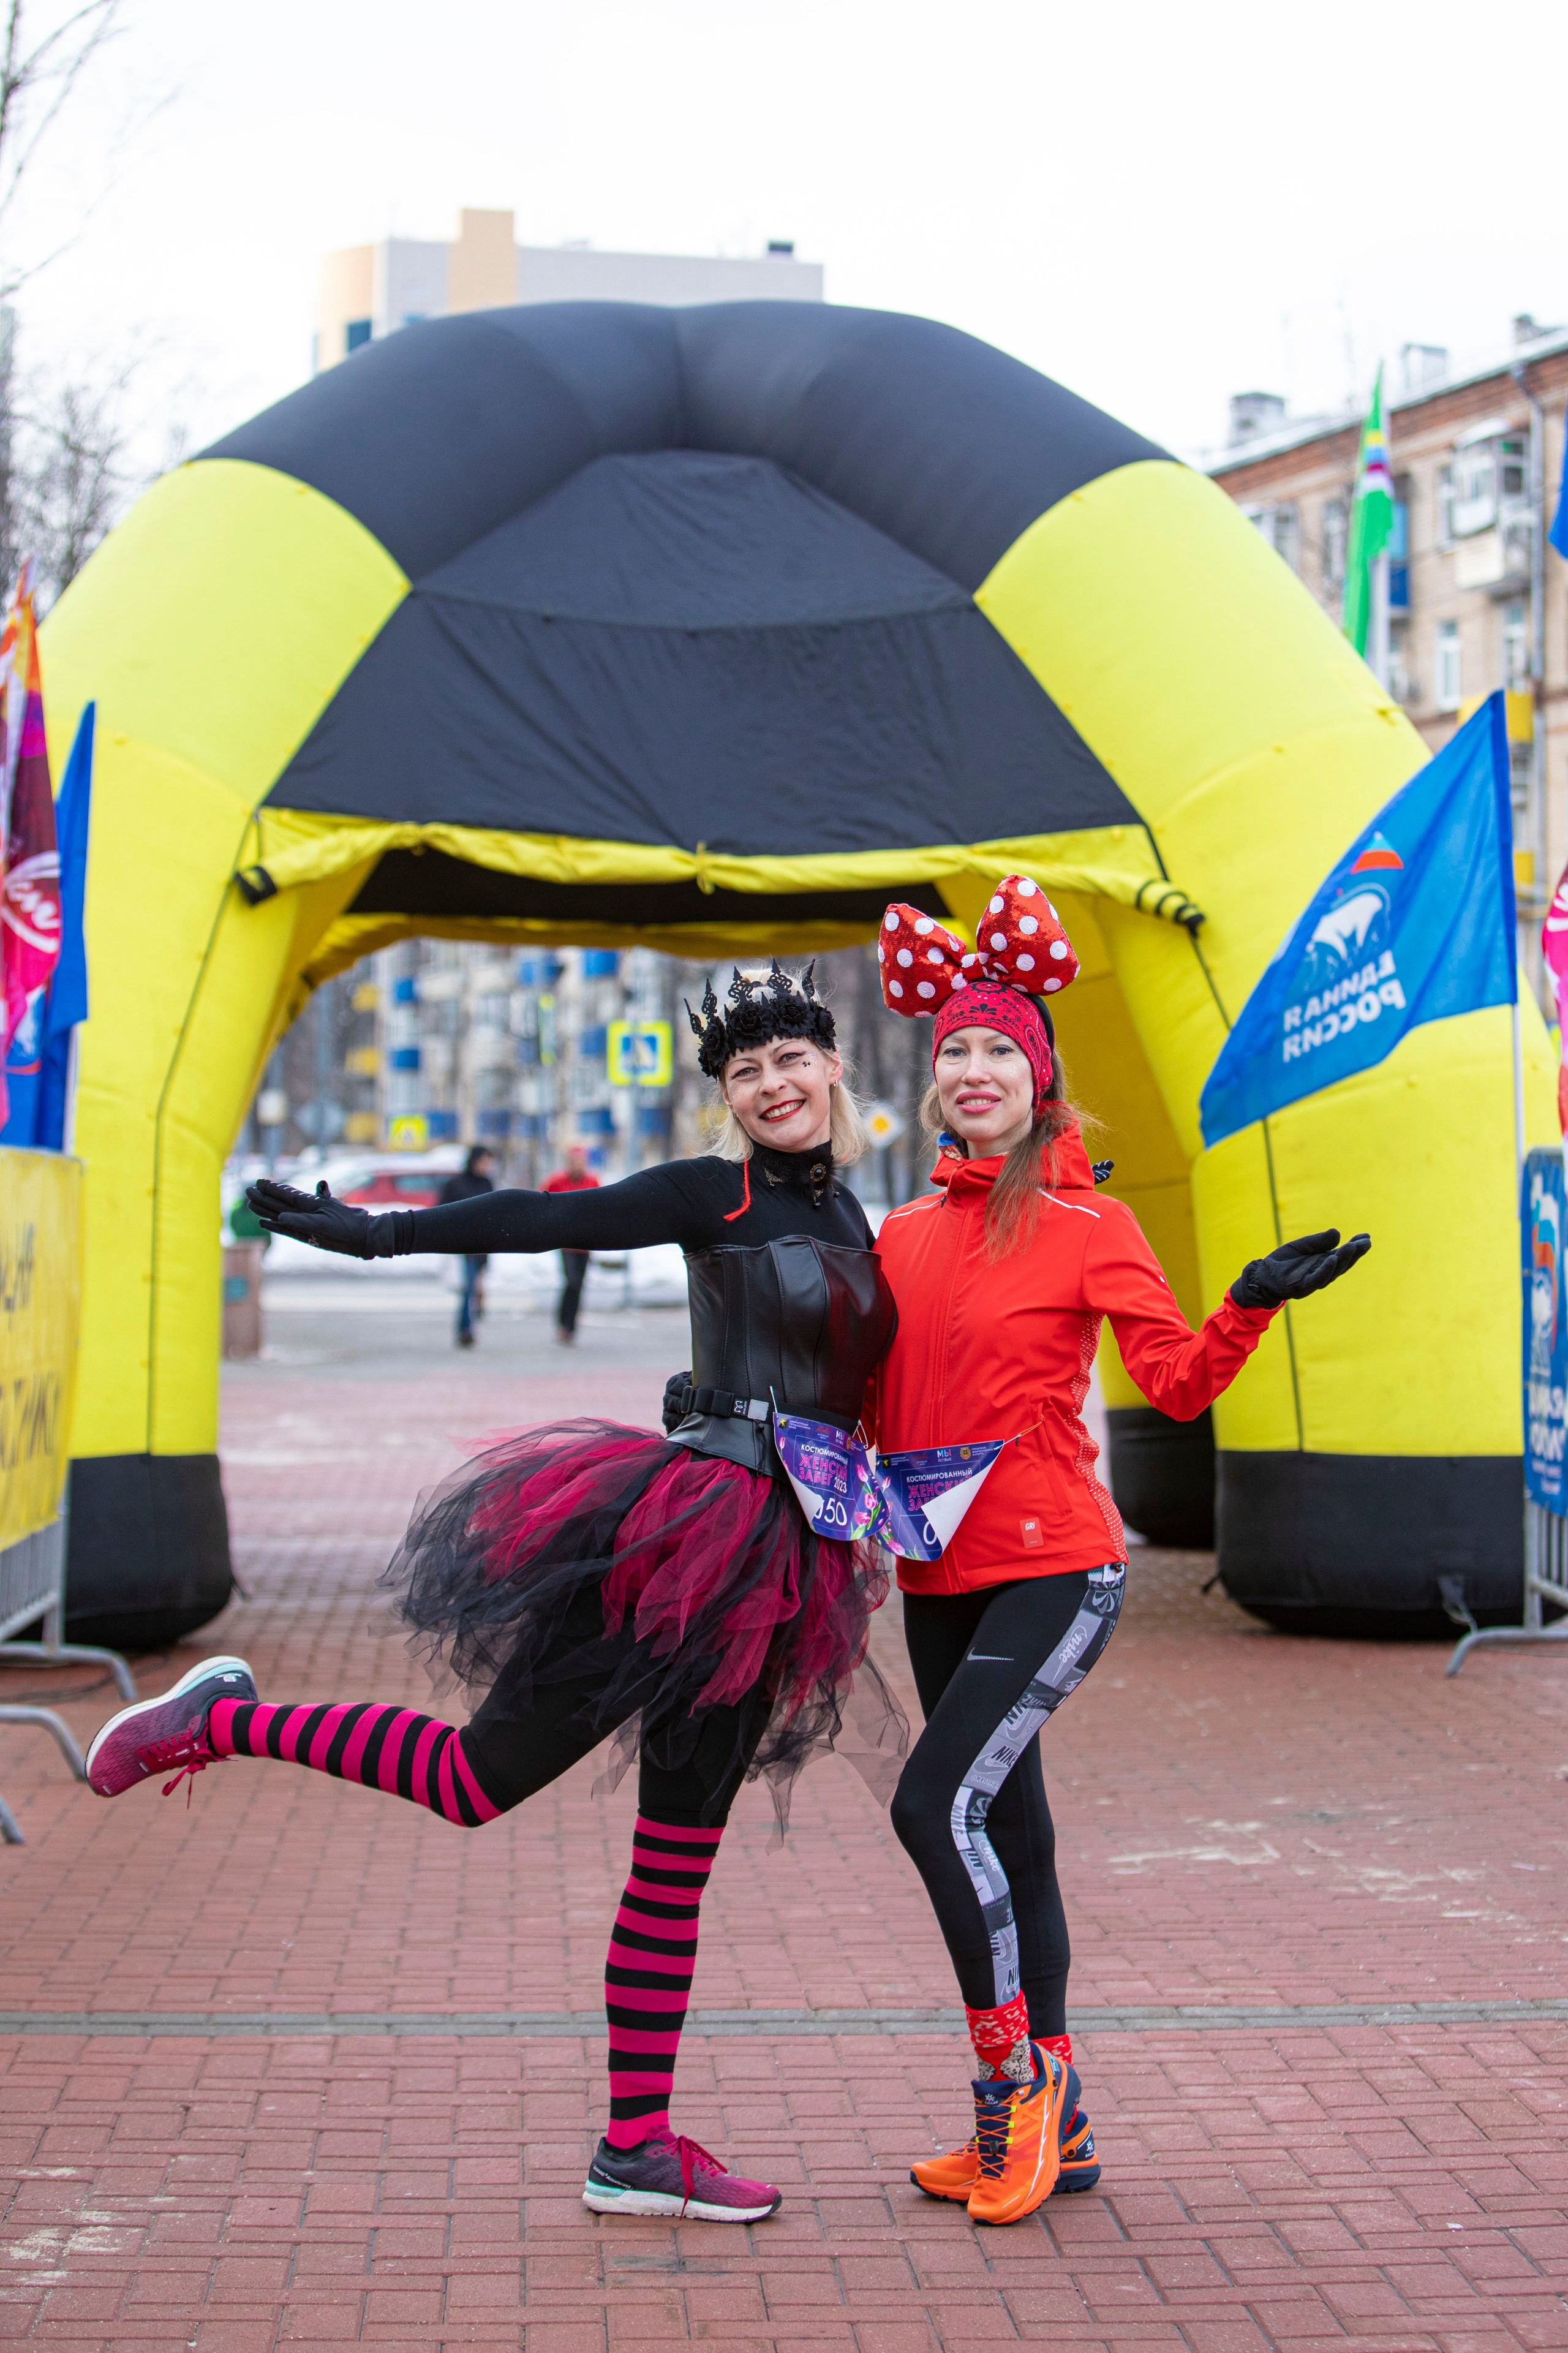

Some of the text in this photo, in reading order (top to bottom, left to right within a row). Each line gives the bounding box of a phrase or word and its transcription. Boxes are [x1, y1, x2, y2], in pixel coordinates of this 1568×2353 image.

[801, 1444, 848, 1465] КОСТЮМИРОВАННЫЙ
[937, 1449, 952, 1458] МЫ
[799, 1453, 848, 1481] ЖЕНСКИЙ
[907, 1467, 973, 1483] КОСТЮМИРОВАННЫЙ
[799, 1467, 847, 1494] ЗАБЕГ 2023
[908, 1476, 972, 1499] ЖЕНСК
